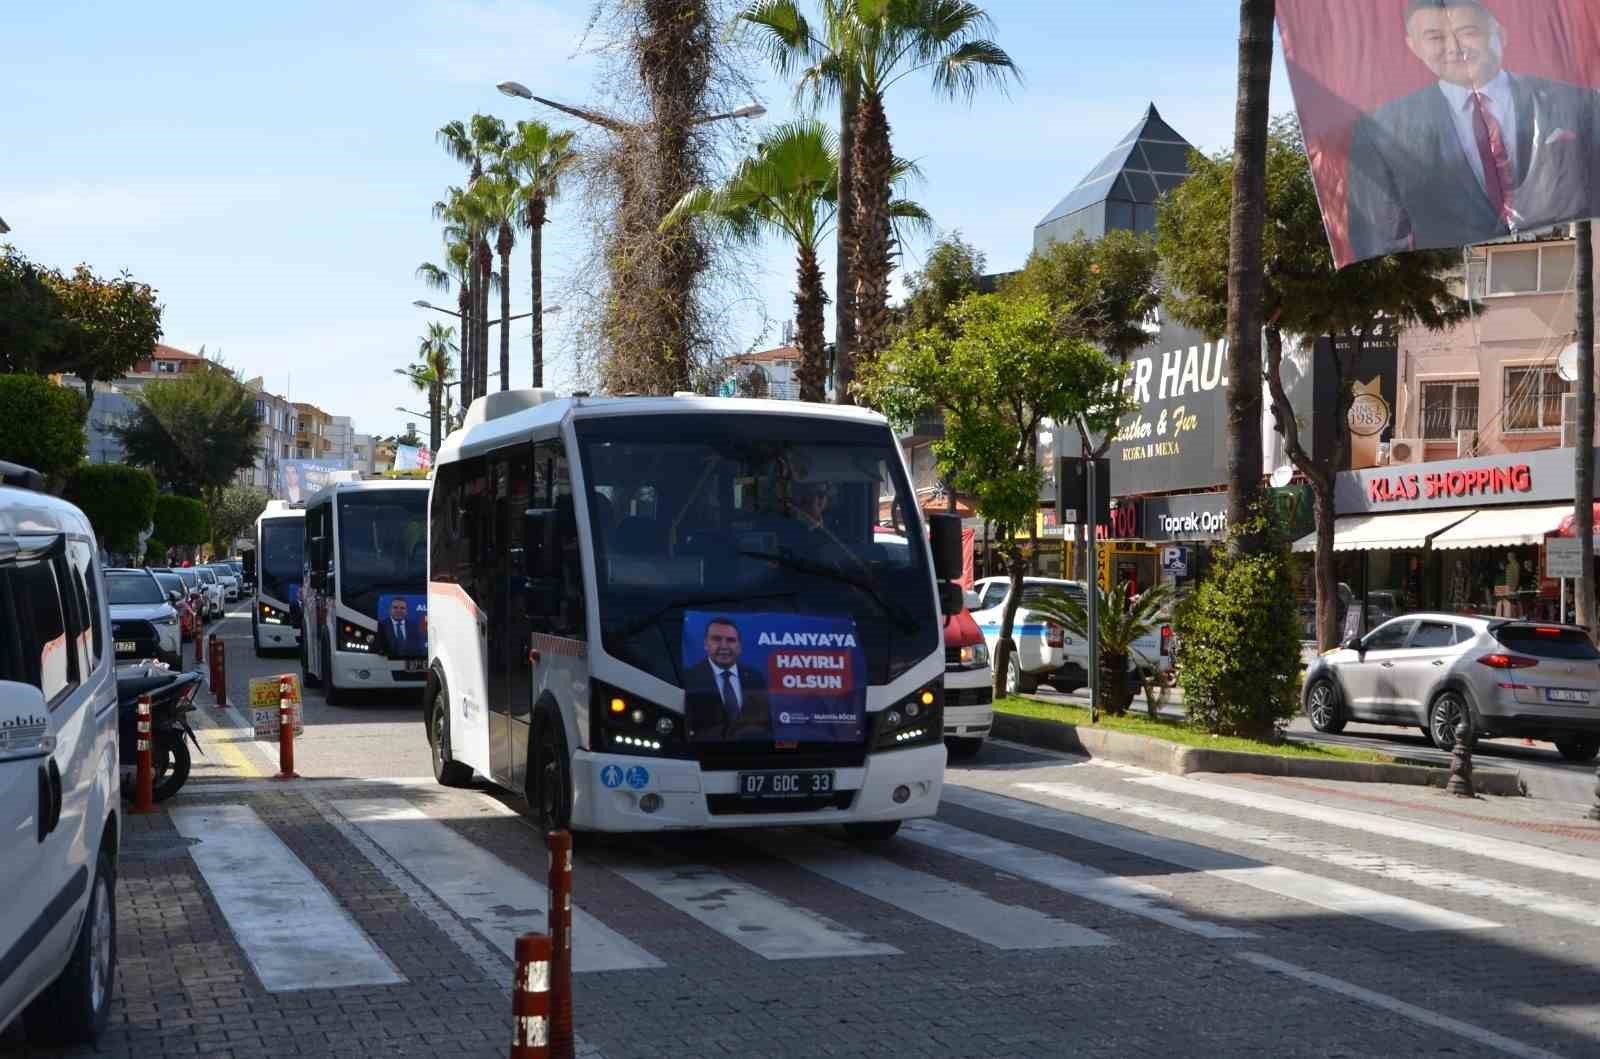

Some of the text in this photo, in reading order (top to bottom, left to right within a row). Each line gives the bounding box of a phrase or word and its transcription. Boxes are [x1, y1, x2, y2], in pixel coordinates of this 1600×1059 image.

[1157, 408, 1168, 436] &
[1172, 405, 1198, 438] Fur
[1368, 463, 1532, 502] KLAS SHOPPING
[1158, 511, 1199, 535] Toprak
[1164, 548, 1181, 565] P
[758, 631, 856, 647] ALANYA'YA
[776, 654, 844, 669] HAYIRLI
[782, 674, 842, 689] OLSUN
[747, 775, 764, 792] 07
[811, 774, 829, 791] 33
